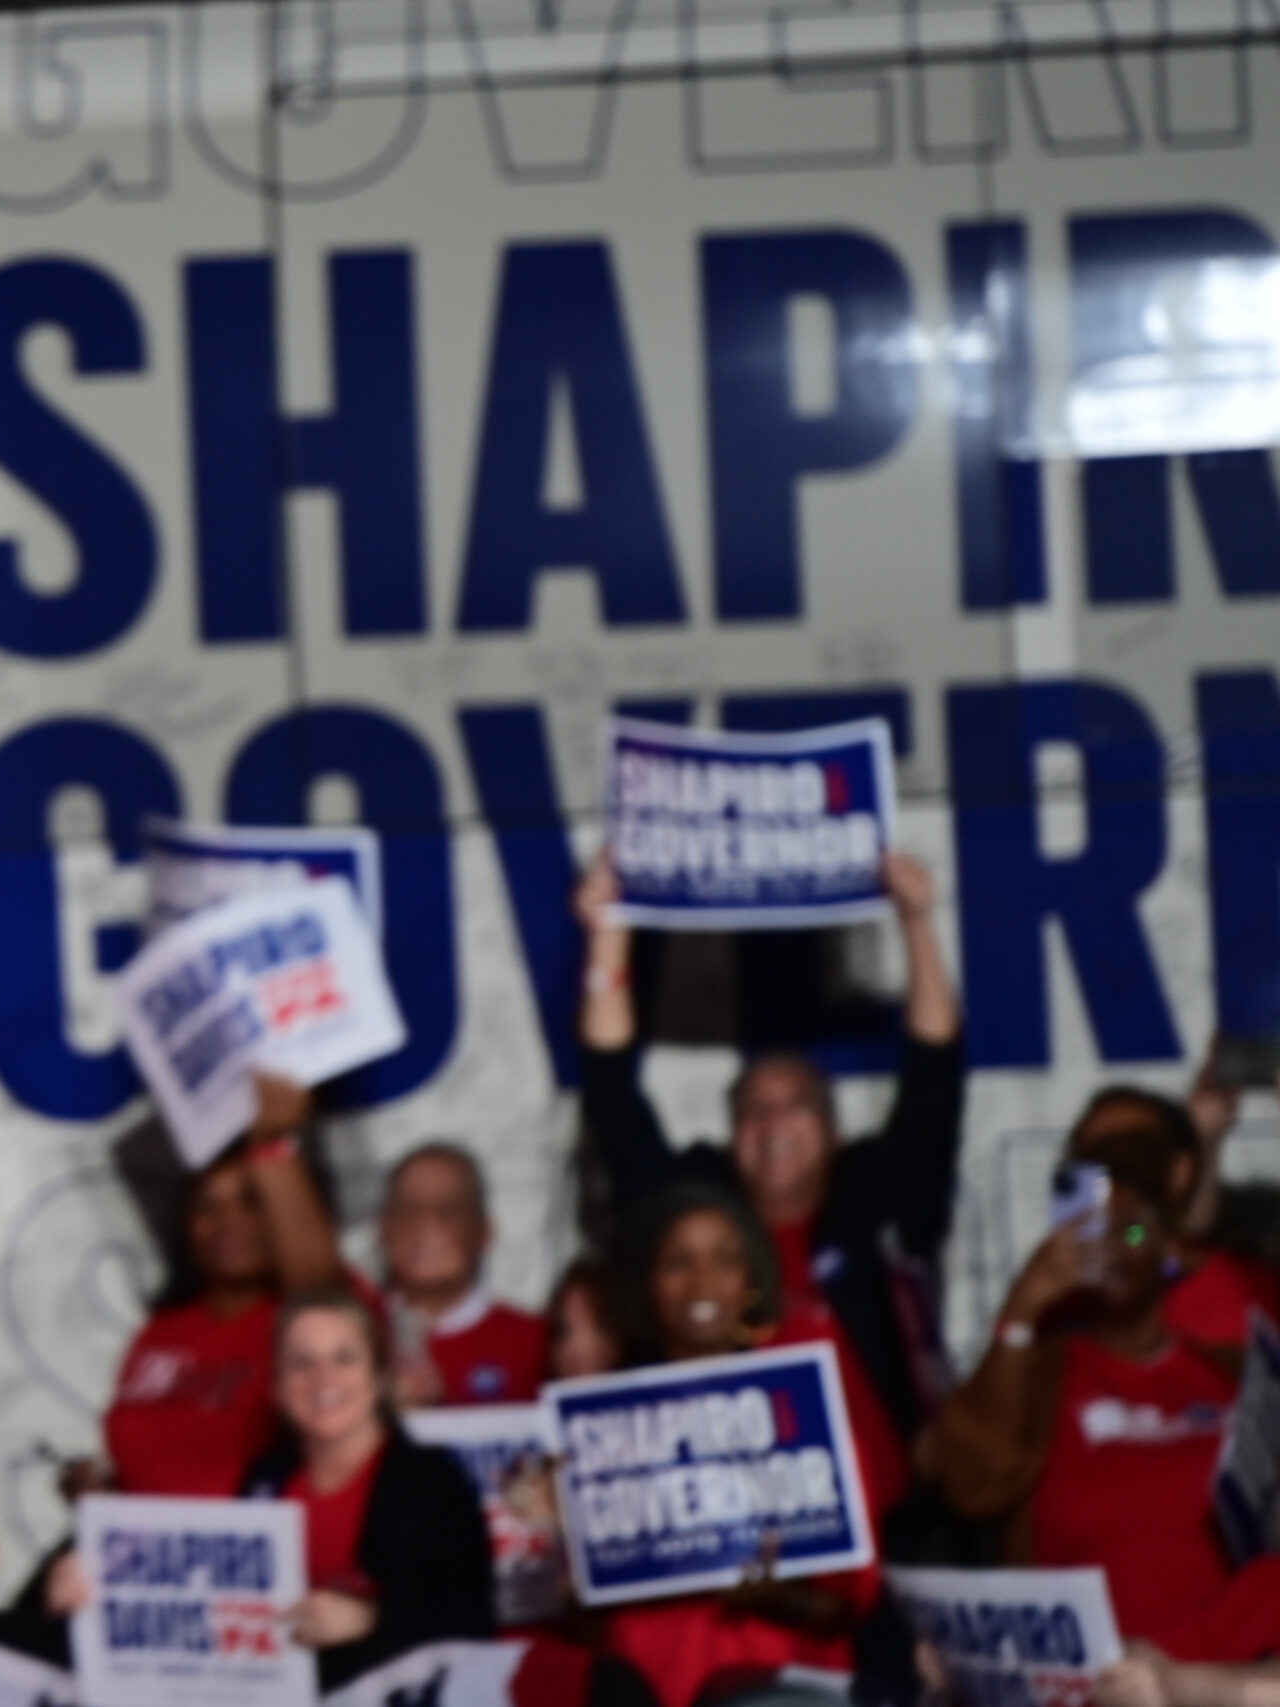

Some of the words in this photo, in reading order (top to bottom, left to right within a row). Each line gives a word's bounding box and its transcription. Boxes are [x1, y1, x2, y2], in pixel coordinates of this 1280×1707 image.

[569, 1386, 778, 1474] SHAPIRO
[579, 1446, 839, 1545] GOVERNOR
[101, 1527, 274, 1590] SHAPIRO
[102, 1597, 212, 1654] DAVIS
[910, 1597, 1087, 1669] HAPIRO
